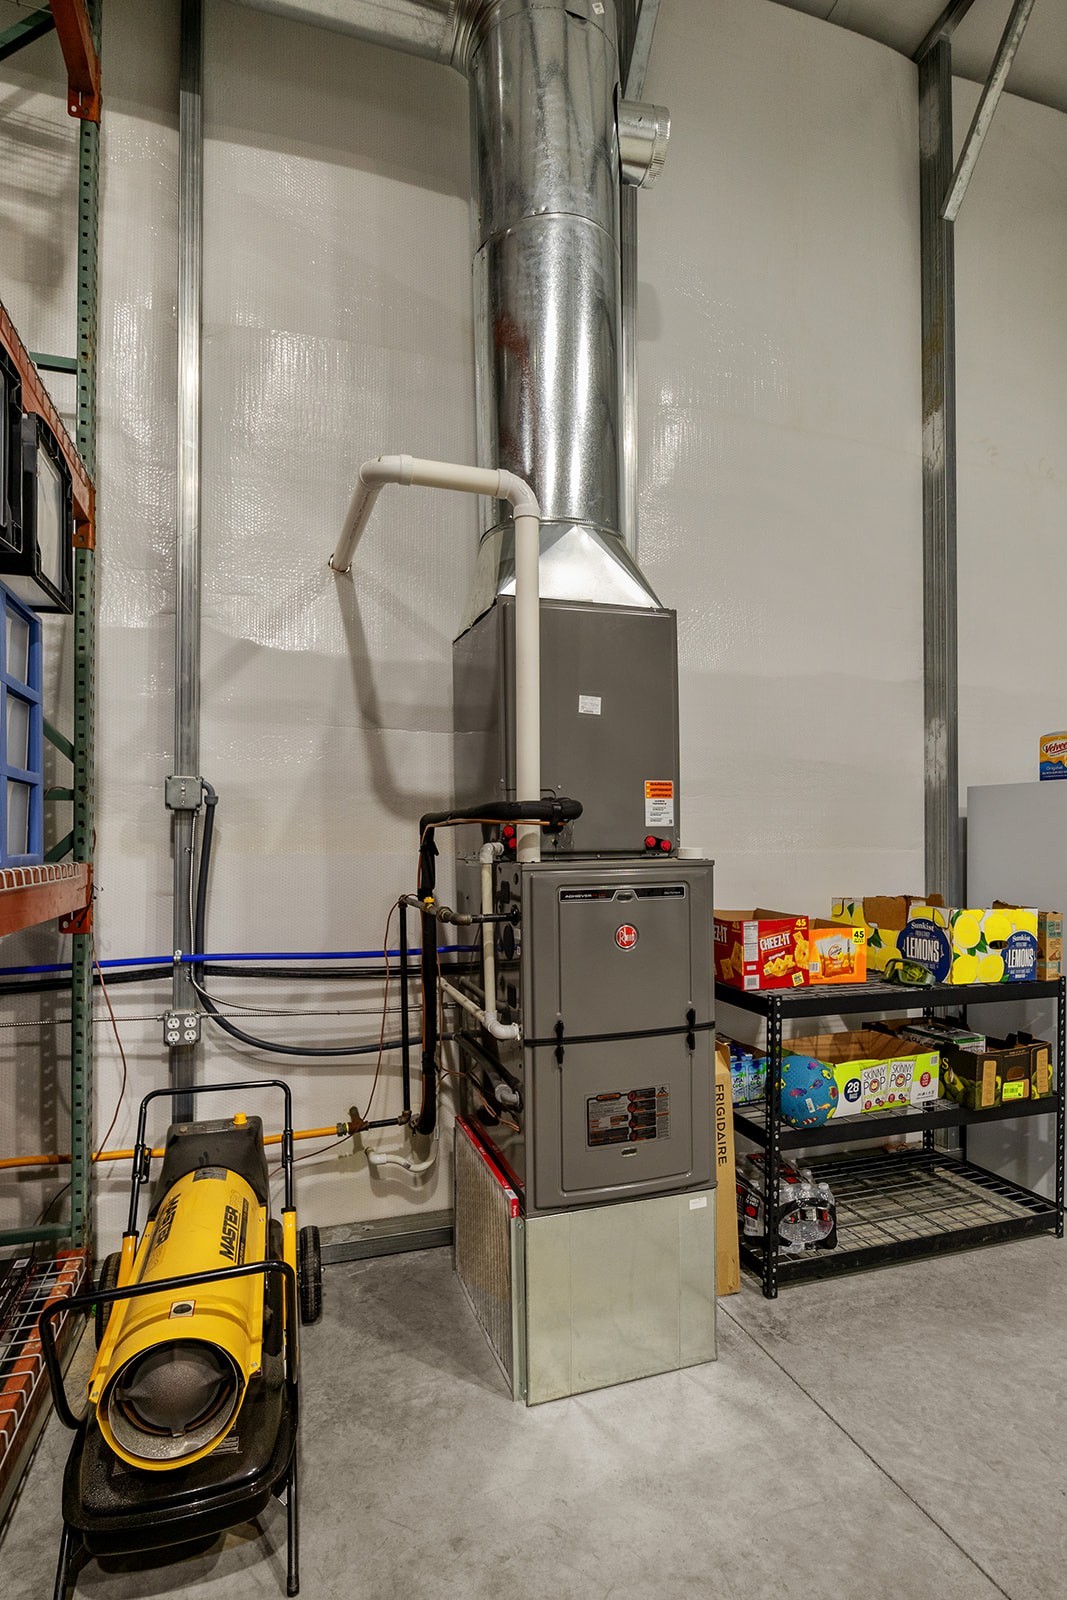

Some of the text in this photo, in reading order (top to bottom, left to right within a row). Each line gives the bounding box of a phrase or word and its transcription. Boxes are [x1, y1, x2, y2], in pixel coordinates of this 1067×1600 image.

[853, 930, 864, 939] 45
[911, 922, 934, 932] Sunkist
[906, 936, 940, 962] LEMONS
[1008, 948, 1034, 968] LEMONS
[863, 1066, 886, 1081] SKINNY
[892, 1063, 914, 1074] SKINNY
[847, 1081, 860, 1093] 28
[715, 1084, 727, 1164] FRIGIDAIRE
[155, 1193, 181, 1249] MASTER
[219, 1205, 239, 1262] MASTER
